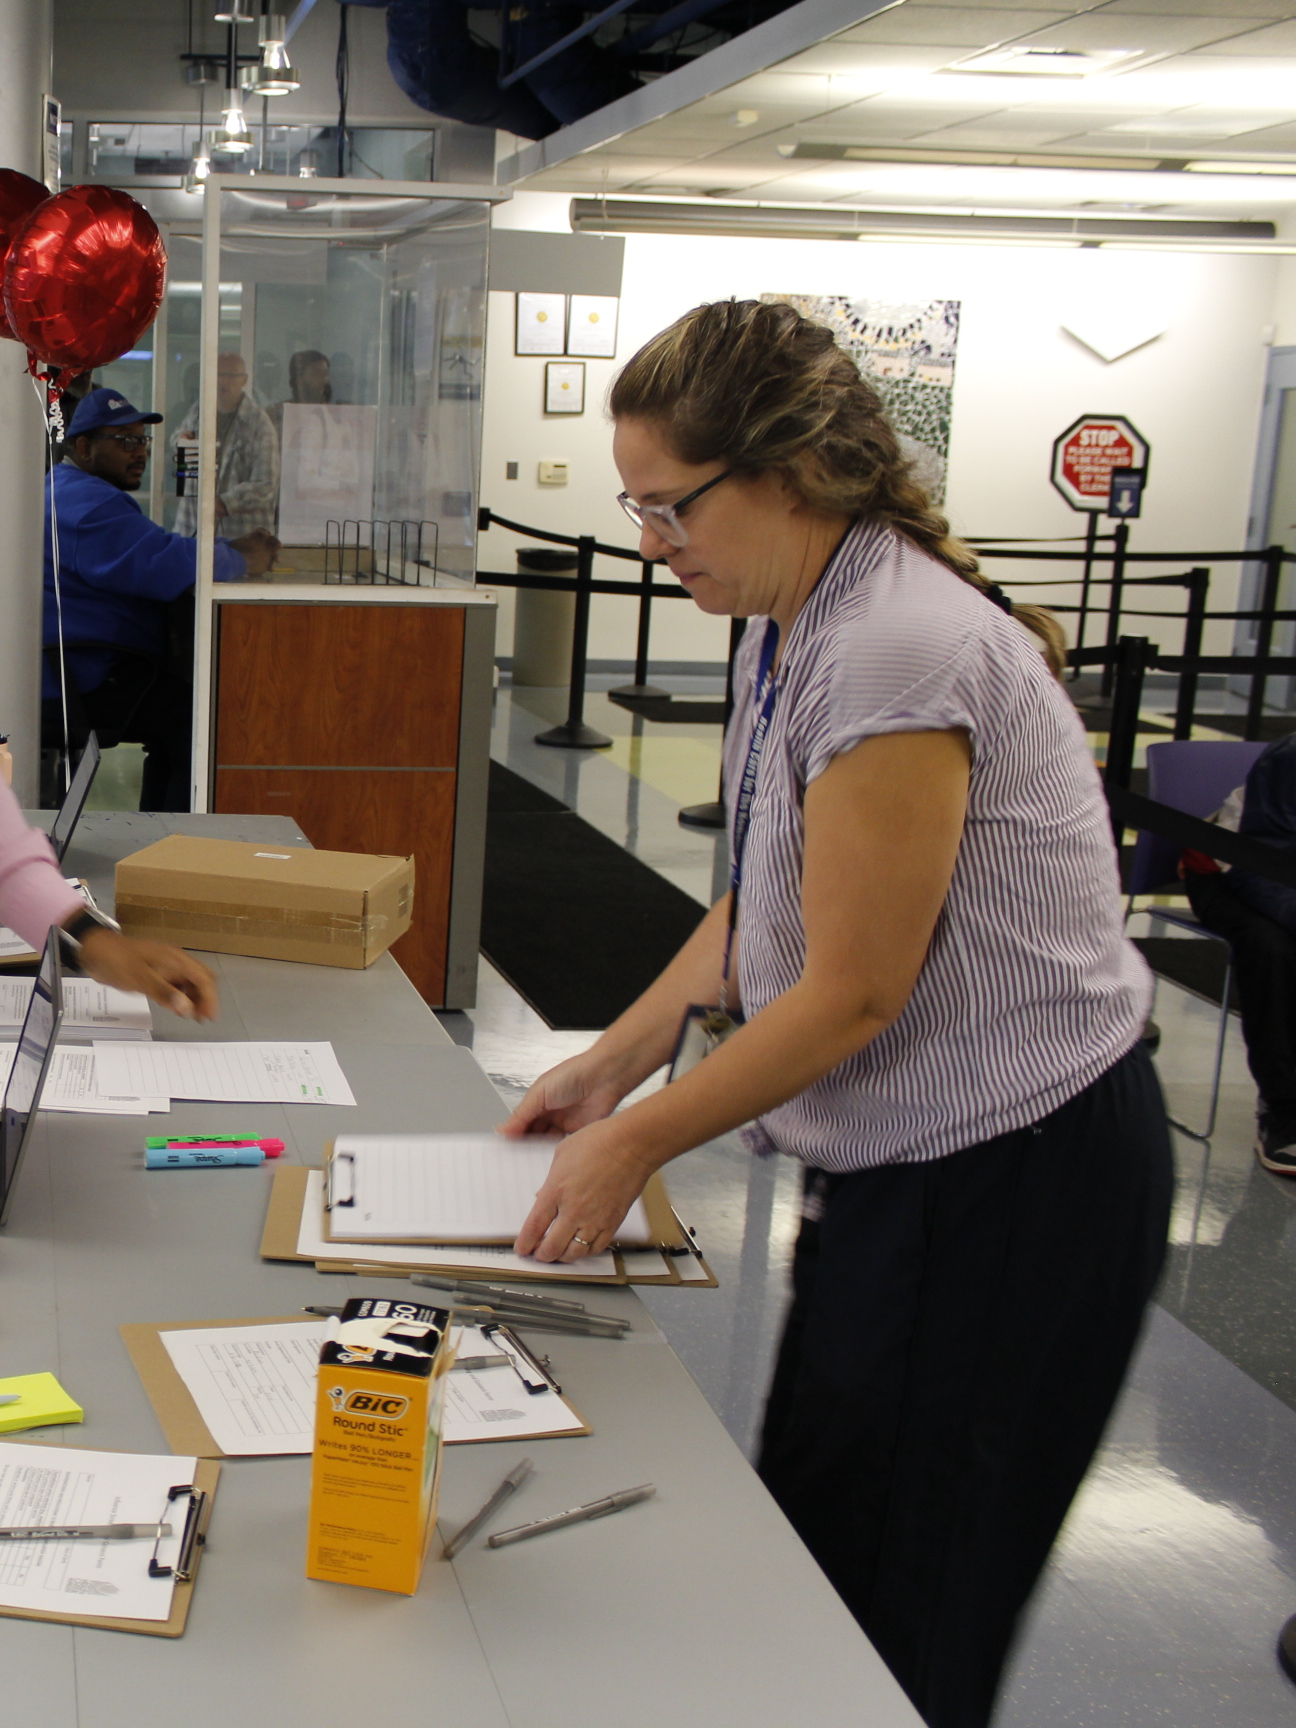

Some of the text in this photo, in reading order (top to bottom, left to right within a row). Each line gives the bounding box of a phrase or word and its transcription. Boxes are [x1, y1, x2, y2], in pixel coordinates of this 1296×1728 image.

[1079, 429, 1120, 446] STOP
[1067, 446, 1103, 455] PLEASE
[1066, 455, 1131, 466] TO BE CALLED
[392, 1304, 418, 1321] 60
[333, 1416, 376, 1432] Round
[318, 1439, 347, 1450] Writes
[350, 1444, 370, 1454] 90%
